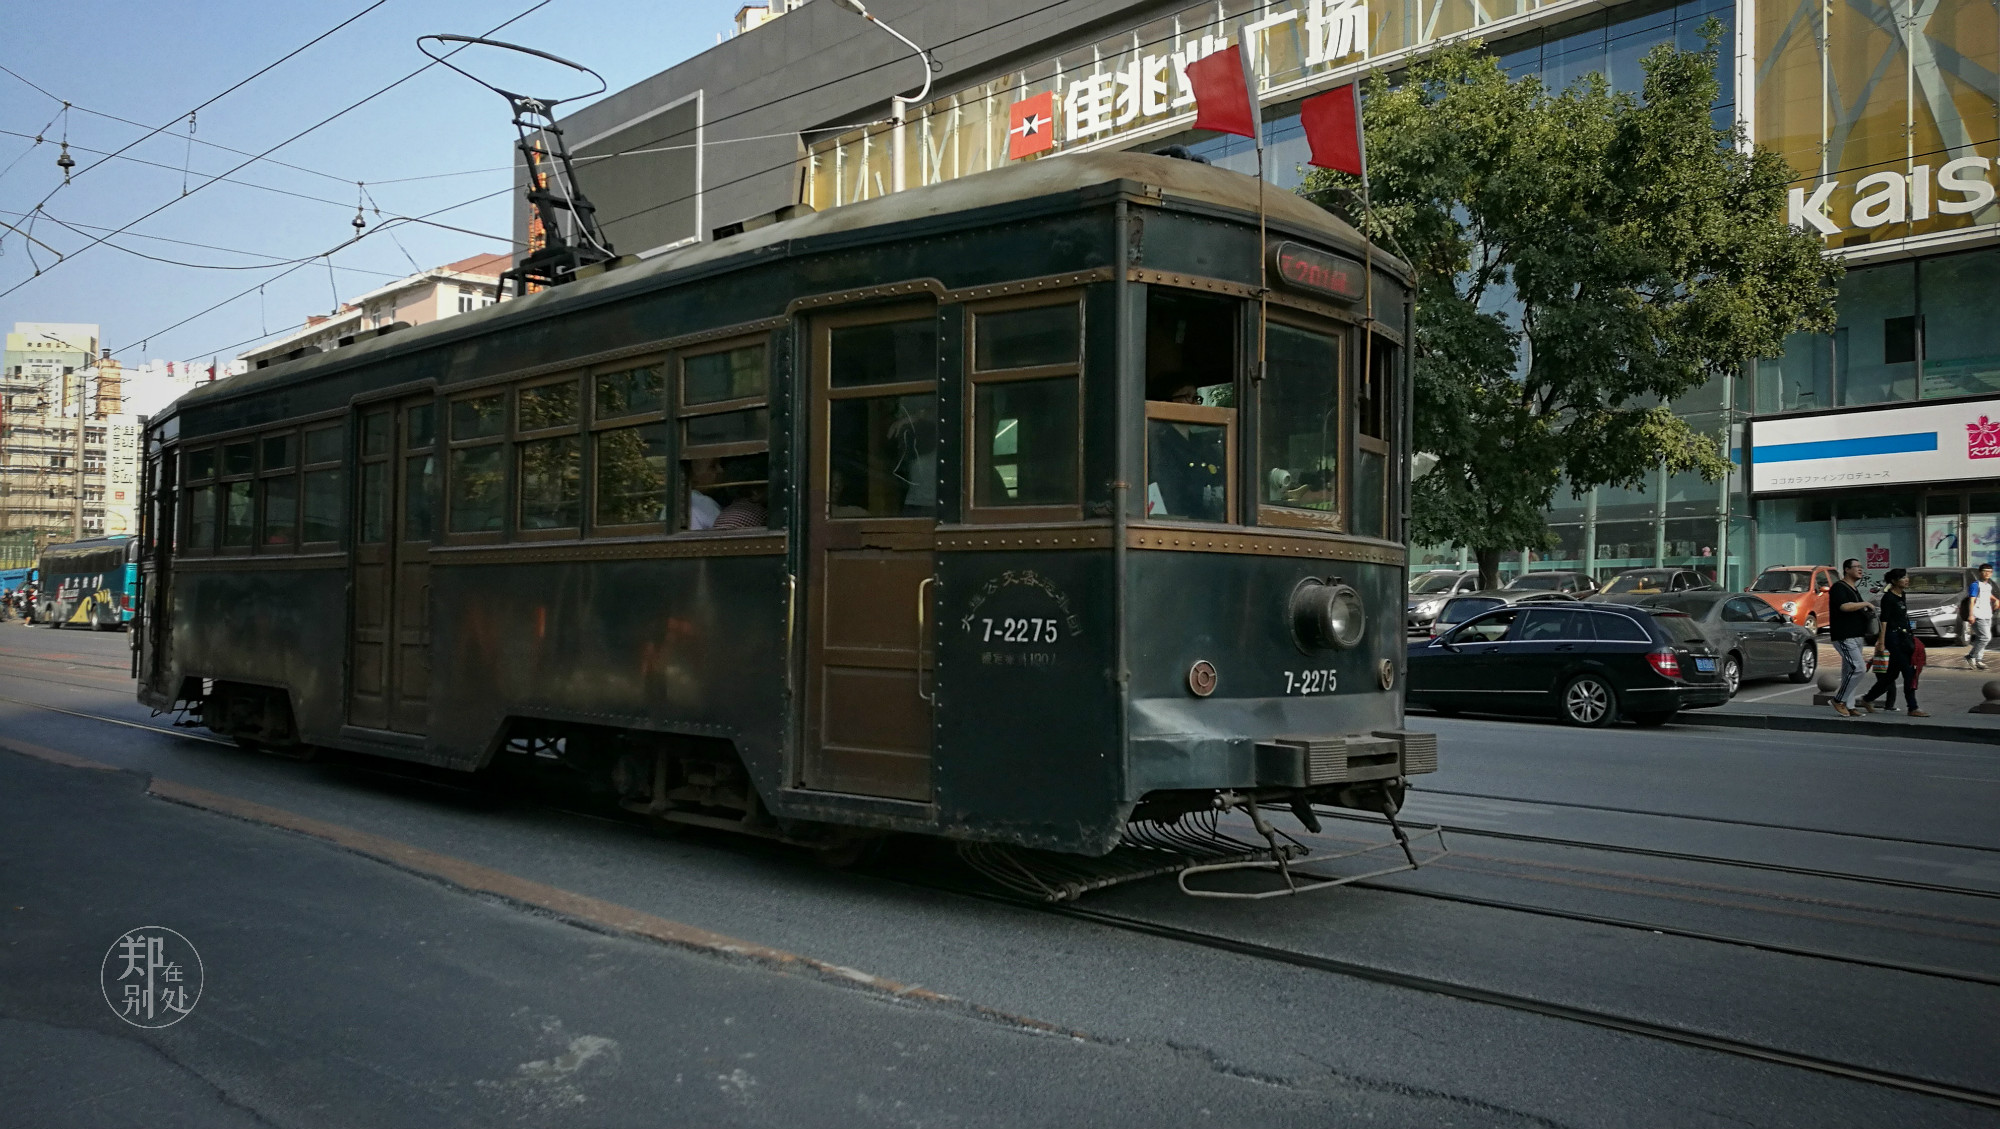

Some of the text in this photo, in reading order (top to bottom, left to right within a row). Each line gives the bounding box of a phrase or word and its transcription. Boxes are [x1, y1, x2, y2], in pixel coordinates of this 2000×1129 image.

[1788, 156, 2000, 235] Kais
[982, 617, 1058, 643] 7-2275
[1284, 669, 1337, 694] 7-2275
